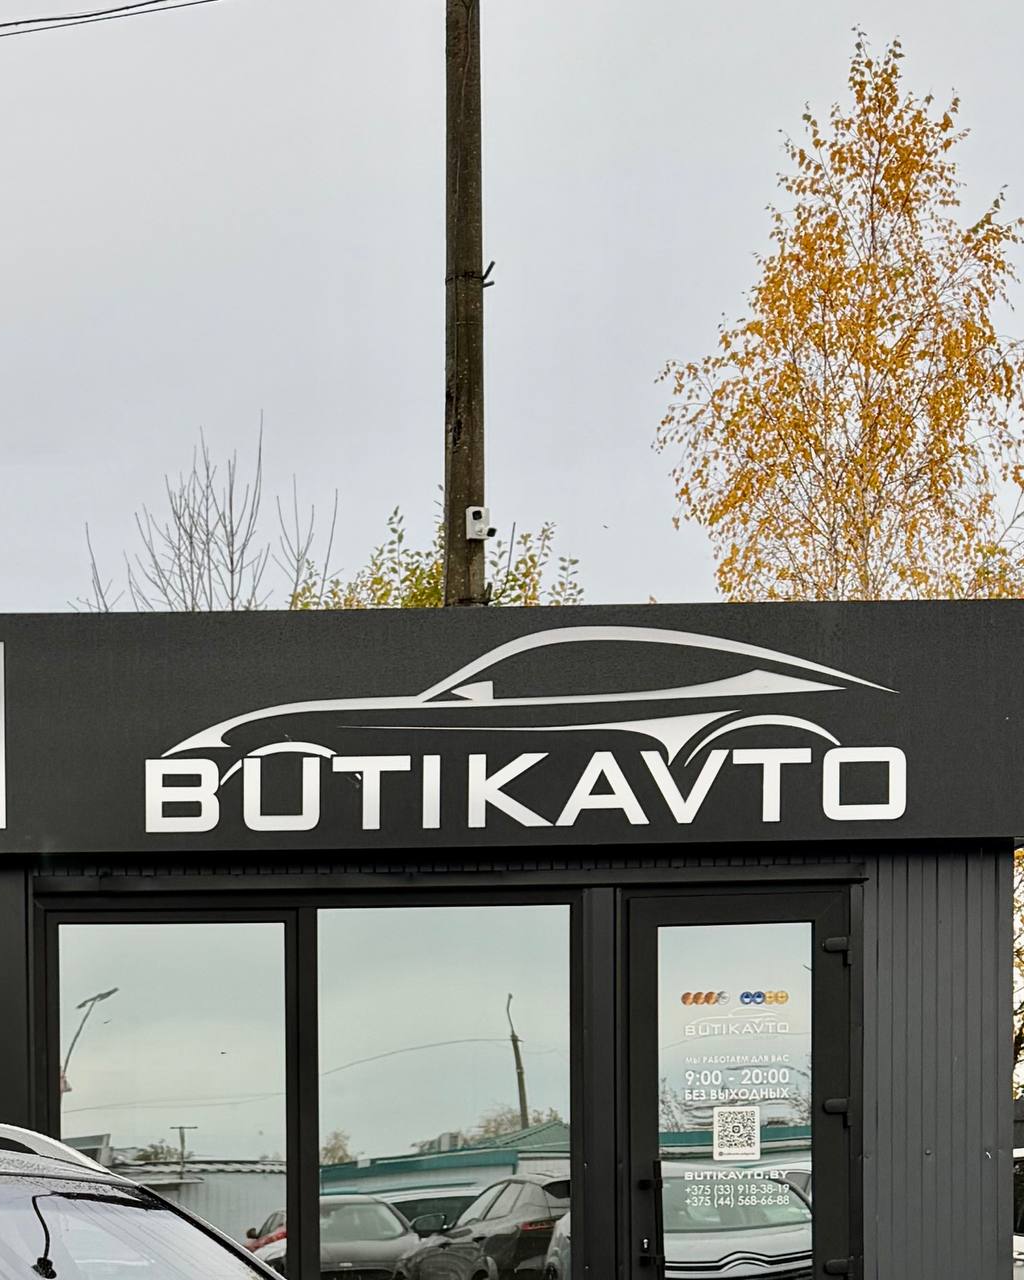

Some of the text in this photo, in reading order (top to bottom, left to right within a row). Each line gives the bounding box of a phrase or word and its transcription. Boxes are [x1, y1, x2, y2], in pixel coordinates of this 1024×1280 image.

[145, 746, 906, 833] BUTIKAVTO
[685, 1022, 789, 1036] BUTIKAVTO
[702, 1055, 749, 1064] РАБОТАЕМ
[771, 1054, 790, 1063] ВАС
[685, 1070, 722, 1085] 9:00
[741, 1068, 789, 1084] 20:00
[685, 1088, 790, 1100] БЕЗ ВЫХОДНЫХ
[684, 1171, 789, 1180] BUTIKAVTO.BY
[685, 1184, 790, 1197] +375 (33) 918-38-19
[685, 1195, 790, 1208] +375 (44) 568-66-88
